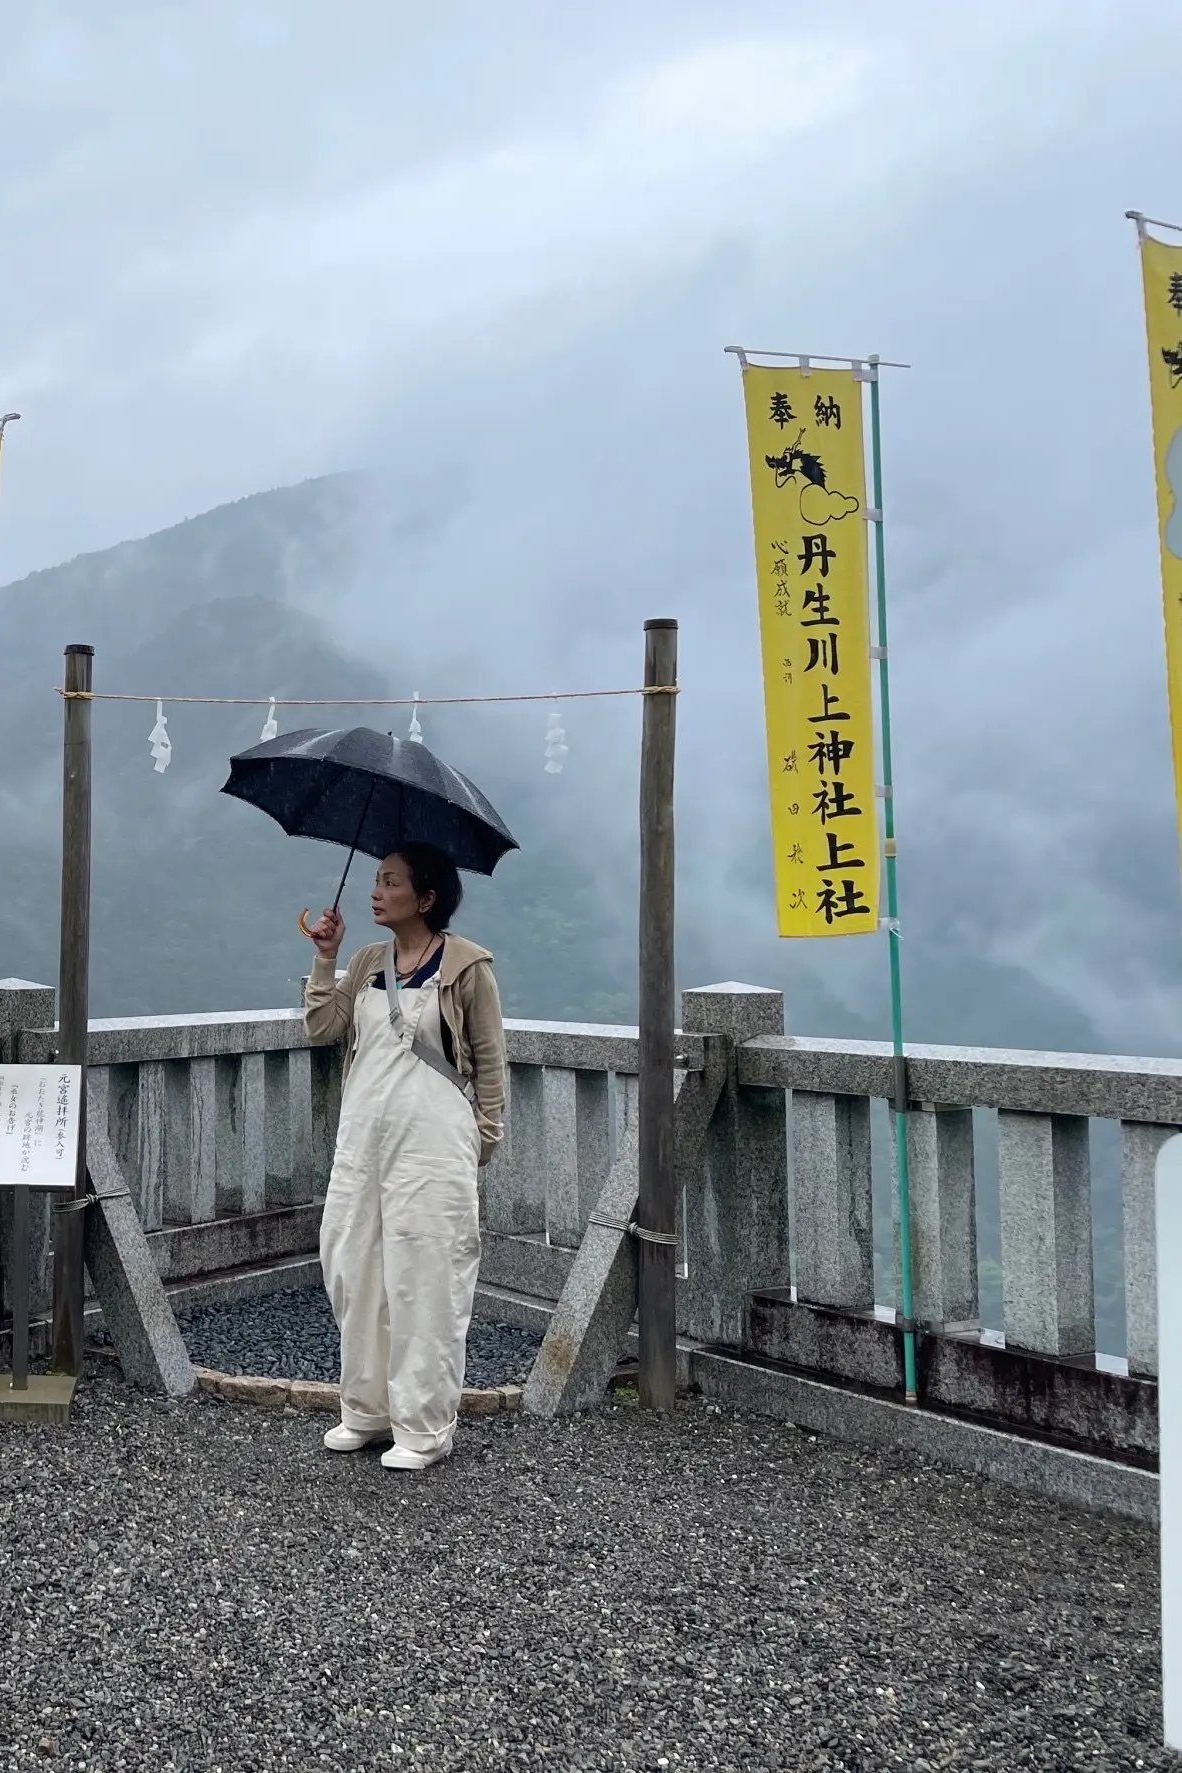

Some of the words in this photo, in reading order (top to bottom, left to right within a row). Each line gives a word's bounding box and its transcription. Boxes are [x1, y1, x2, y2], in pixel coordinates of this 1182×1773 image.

[768, 391, 842, 430] 奉納
[770, 539, 792, 617] 心願成就
[796, 533, 871, 925] 丹生川上神社上社
